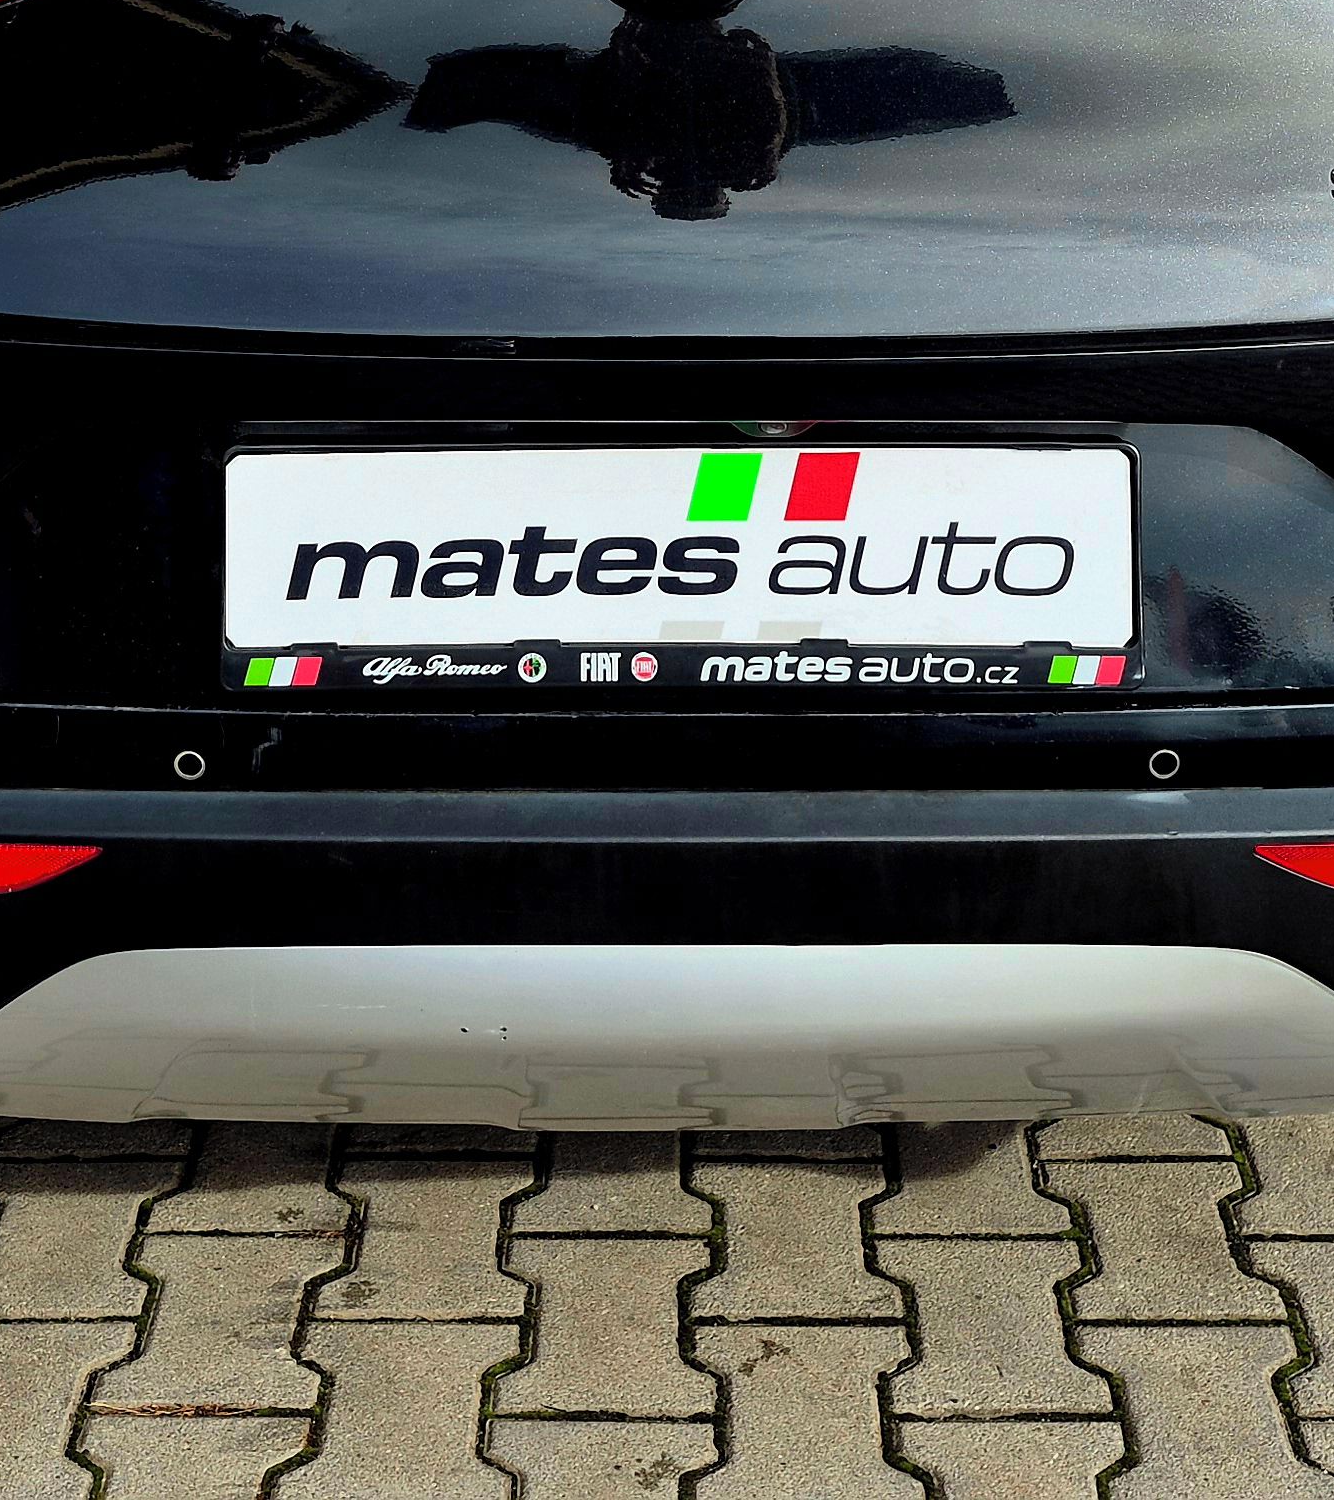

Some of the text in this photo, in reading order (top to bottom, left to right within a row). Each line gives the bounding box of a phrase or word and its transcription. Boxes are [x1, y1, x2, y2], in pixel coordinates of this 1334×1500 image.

[286, 521, 1075, 600] mates auto
[362, 656, 422, 685] Alfa
[423, 654, 507, 676] Romeo
[580, 652, 622, 682] FIAT
